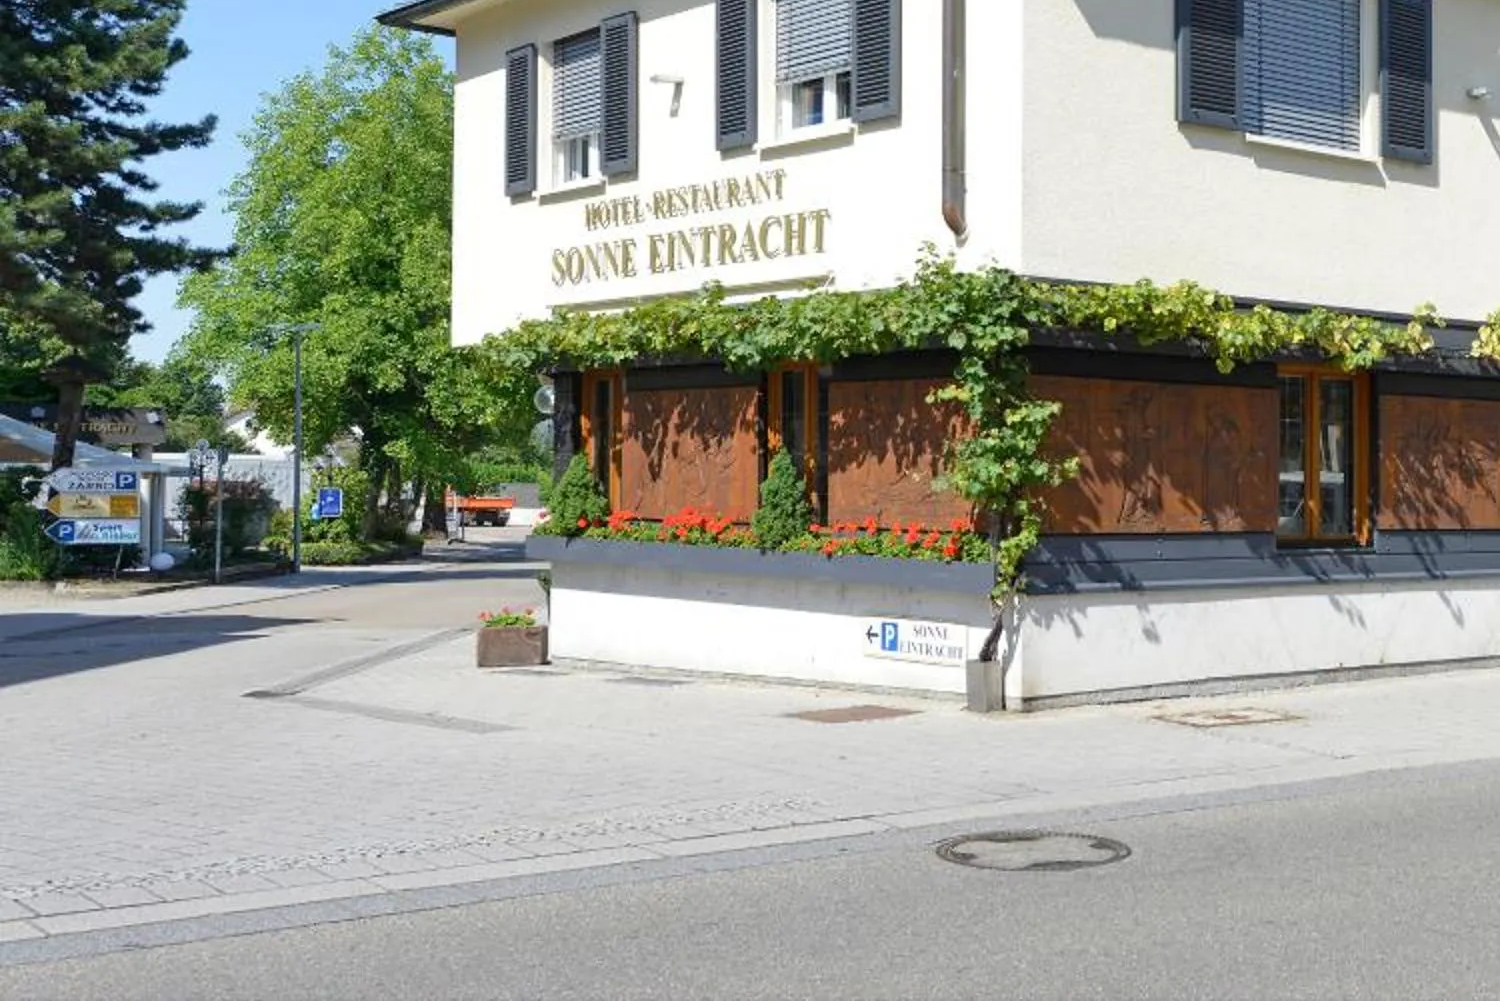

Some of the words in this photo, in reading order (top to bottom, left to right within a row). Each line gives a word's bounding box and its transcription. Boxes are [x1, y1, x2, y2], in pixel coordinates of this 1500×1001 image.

[552, 238, 637, 287] SONNE
[648, 208, 832, 274] EINTRACHT
[120, 474, 133, 488] P
[60, 525, 73, 538] P
[884, 624, 896, 648] P
[913, 624, 949, 641] SONNE
[900, 640, 964, 661] EINTRACHT
